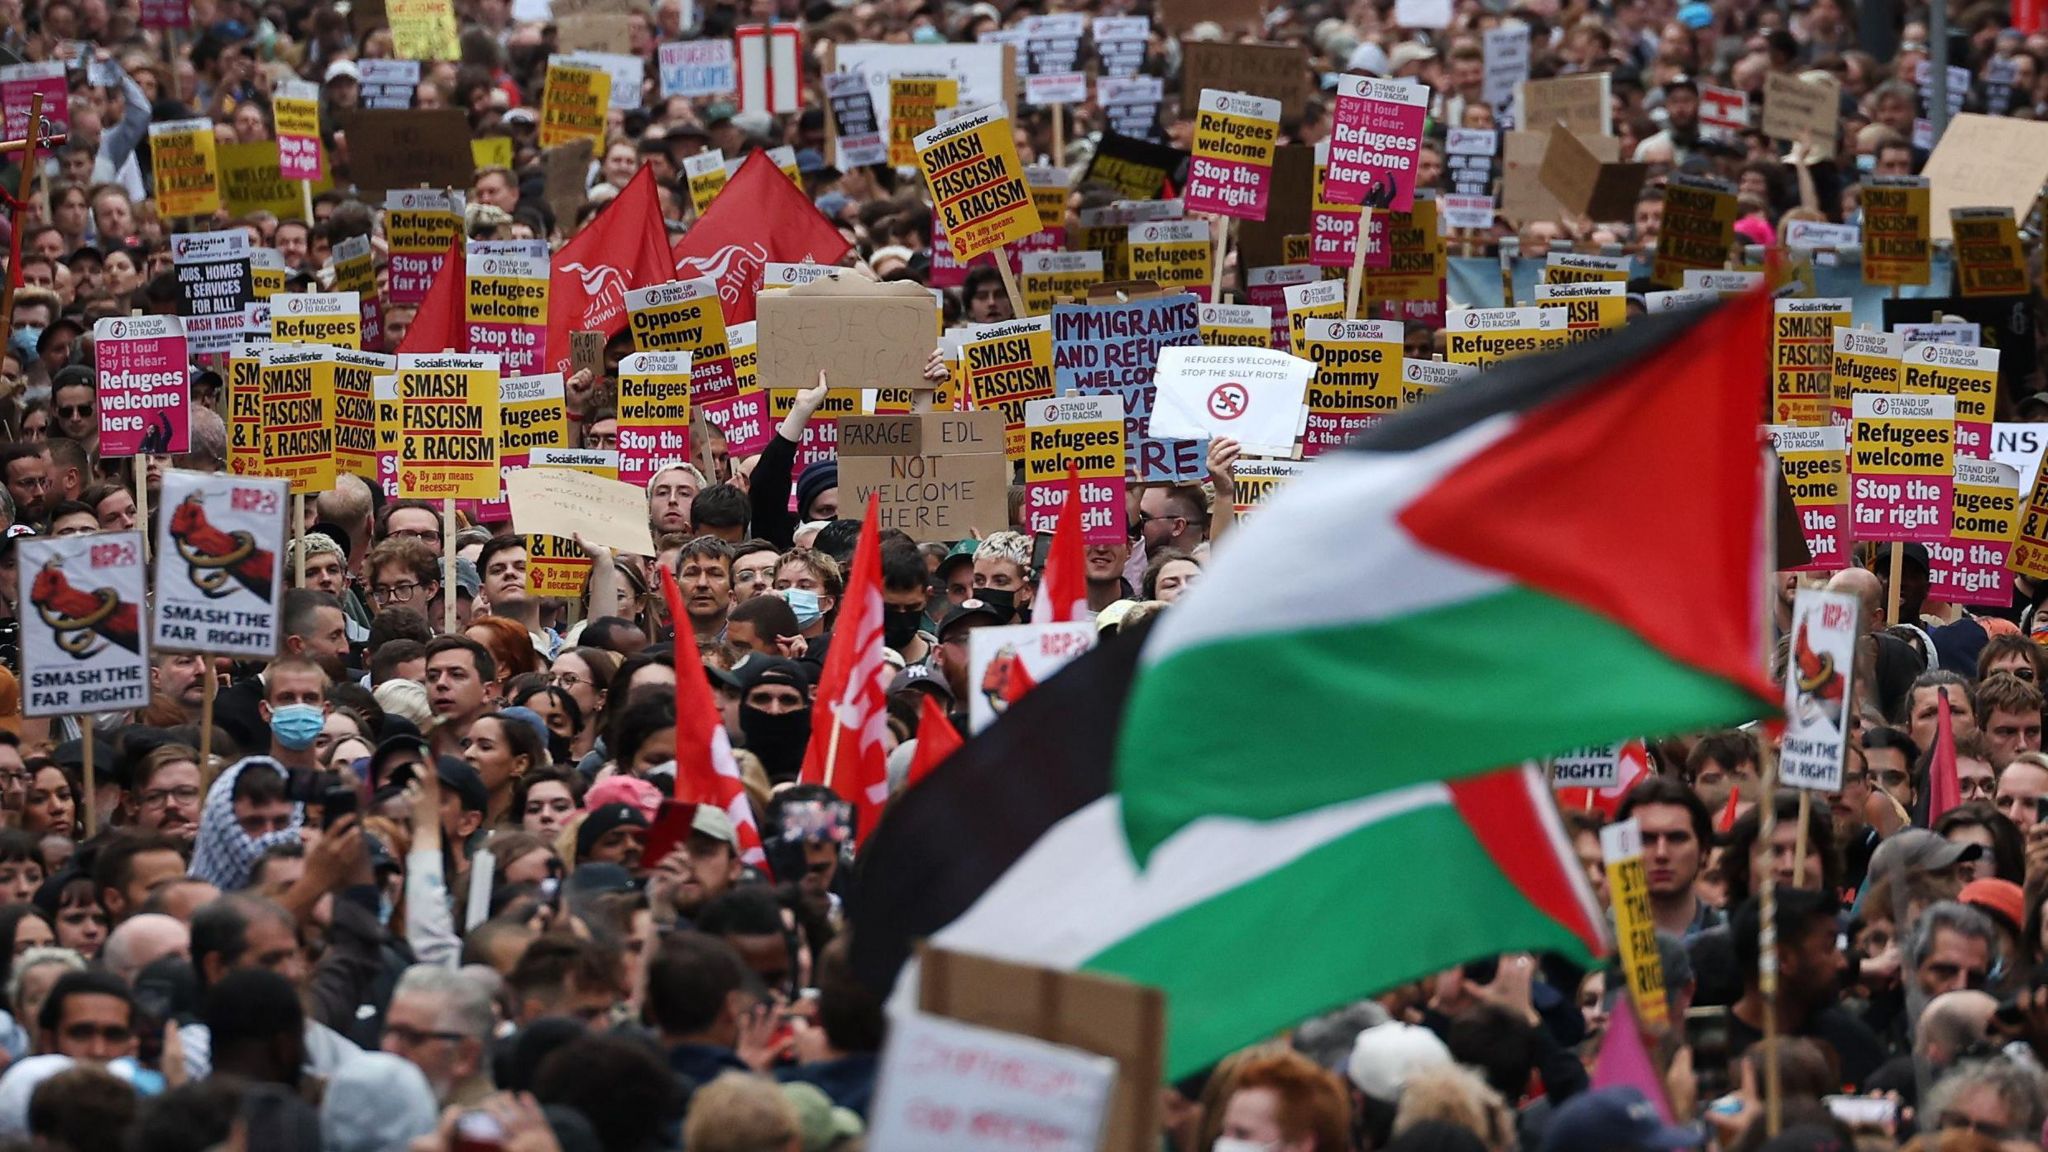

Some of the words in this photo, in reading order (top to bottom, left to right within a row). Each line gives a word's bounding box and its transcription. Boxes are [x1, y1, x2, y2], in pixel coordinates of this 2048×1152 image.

[1340, 99, 1360, 112] Say
[1362, 102, 1372, 113] it
[1374, 104, 1399, 116] loud
[1200, 115, 1273, 141] Refugees
[1338, 111, 1359, 125] Say
[1361, 114, 1370, 124] it
[1372, 116, 1404, 130] clear:
[1198, 138, 1266, 158] welcome
[1335, 124, 1416, 151] Refugees
[923, 132, 984, 174] SMASH
[1332, 146, 1409, 169] welcome
[932, 154, 1007, 202] FASCISM
[1193, 160, 1230, 180] Stop
[1233, 165, 1260, 184] the
[1329, 163, 1370, 185] here
[1190, 180, 1212, 198] far
[1216, 185, 1257, 206] right
[944, 207, 960, 229] &
[959, 179, 1027, 223] RACISM
[991, 215, 1015, 230] means
[1316, 215, 1353, 235] Stop
[969, 231, 1006, 249] necessary
[1315, 235, 1338, 252] far
[392, 255, 428, 275] Stop
[1133, 247, 1206, 265] Refugees
[178, 266, 204, 282] JOBS,
[205, 263, 243, 280] HOMES
[393, 274, 416, 290] far
[1133, 267, 1204, 283] welcome
[193, 280, 241, 297] SERVICES
[470, 279, 544, 301] Refugees
[192, 298, 210, 315] FOR
[212, 296, 235, 312] ALL!
[470, 300, 539, 319] welcome
[633, 304, 701, 330] Oppose
[1055, 302, 1199, 341] IMMIGRANTS
[1779, 316, 1832, 338] SMASH
[140, 327, 167, 336] RACISM
[276, 319, 356, 340] Refugees
[470, 325, 507, 346] Stop
[511, 327, 535, 346] the
[637, 326, 703, 350] Tommy
[1347, 324, 1368, 332] STAND
[1357, 331, 1383, 340] RACISM
[100, 342, 118, 356] Say
[121, 342, 131, 353] it
[133, 341, 158, 353] loud
[968, 338, 1033, 371] SMASH
[1309, 343, 1382, 367] Oppose
[1452, 335, 1536, 356] Refugees
[100, 355, 118, 369] Say
[121, 356, 131, 367] it
[133, 354, 167, 367] clear:
[1055, 344, 1098, 369] AND
[1184, 355, 1235, 365] REFUGEES
[1237, 356, 1291, 368] WELCOME!
[1949, 357, 1979, 368] RACISM
[1181, 368, 1206, 377] STOP
[1208, 369, 1227, 377] THE
[1228, 369, 1253, 378] SILLY
[1255, 371, 1288, 380] RIOTS!
[1311, 368, 1379, 391] Tommy
[1834, 357, 1897, 382] Refugees
[100, 370, 184, 393] Refugees
[262, 367, 312, 394] SMASH
[403, 373, 468, 398] SMASH
[621, 378, 688, 400] Refugees
[701, 375, 734, 395] right
[972, 366, 1053, 400] FASCISM
[1778, 372, 1790, 393] &
[1905, 367, 1992, 395] Refugees
[101, 391, 181, 411] welcome
[517, 389, 545, 399] RACISM
[1308, 388, 1397, 411] Robinson
[1890, 398, 1915, 408] STAND
[263, 398, 322, 426] FASCISM
[403, 405, 482, 429] FASCISM
[621, 400, 684, 419] welcome
[732, 400, 758, 419] the
[1059, 402, 1084, 412] STAND
[1073, 408, 1102, 420] RACISM
[1902, 407, 1934, 416] RACISM
[101, 412, 144, 431] here
[723, 418, 760, 445] right
[1308, 414, 1337, 430] Stop
[263, 433, 278, 458] &
[279, 428, 332, 457] RACISM
[620, 430, 657, 452] Stop
[660, 430, 682, 449] the
[844, 421, 913, 447] FARAGE
[942, 420, 983, 444] EDL
[1030, 429, 1120, 453] Refugees
[1307, 431, 1318, 444] &
[1320, 430, 1341, 445] the
[1782, 431, 1805, 441] STAND
[1795, 439, 1825, 449] RACISM
[1857, 422, 1950, 448] Refugees
[402, 438, 418, 460] &
[423, 436, 494, 461] RACISM
[1857, 447, 1944, 468] welcome
[619, 456, 644, 472] far
[891, 455, 944, 480] NOT
[1031, 453, 1116, 475] welcome
[1958, 464, 1981, 475] STAND
[420, 471, 431, 482] By
[432, 473, 447, 484] any
[448, 472, 474, 482] means
[1969, 474, 2001, 484] RACISM
[420, 483, 460, 494] necessary
[857, 480, 976, 504] WELCOME
[1079, 482, 1113, 503] the
[1855, 478, 1902, 504] Stop
[1906, 480, 1941, 501] the
[881, 504, 951, 529] HERE
[1030, 510, 1059, 531] far
[1803, 509, 1837, 531] the
[1854, 504, 1884, 524] far
[1889, 505, 1939, 530] right
[2022, 513, 2038, 537] &
[530, 533, 546, 557] &
[1970, 544, 2004, 567] the
[547, 567, 558, 580] By
[1952, 567, 2001, 593] right
[161, 604, 232, 625] SMASH
[235, 611, 271, 629] THE
[161, 623, 197, 641] FAR
[207, 629, 271, 648] RIGHT!
[30, 670, 102, 689] SMASH
[106, 665, 142, 682] THE
[31, 692, 70, 708] FAR
[80, 684, 144, 705] RIGHT!
[1816, 742, 1838, 760] THE
[1554, 762, 1614, 781] RIGHT!
[1799, 761, 1837, 781] RIGHT!
